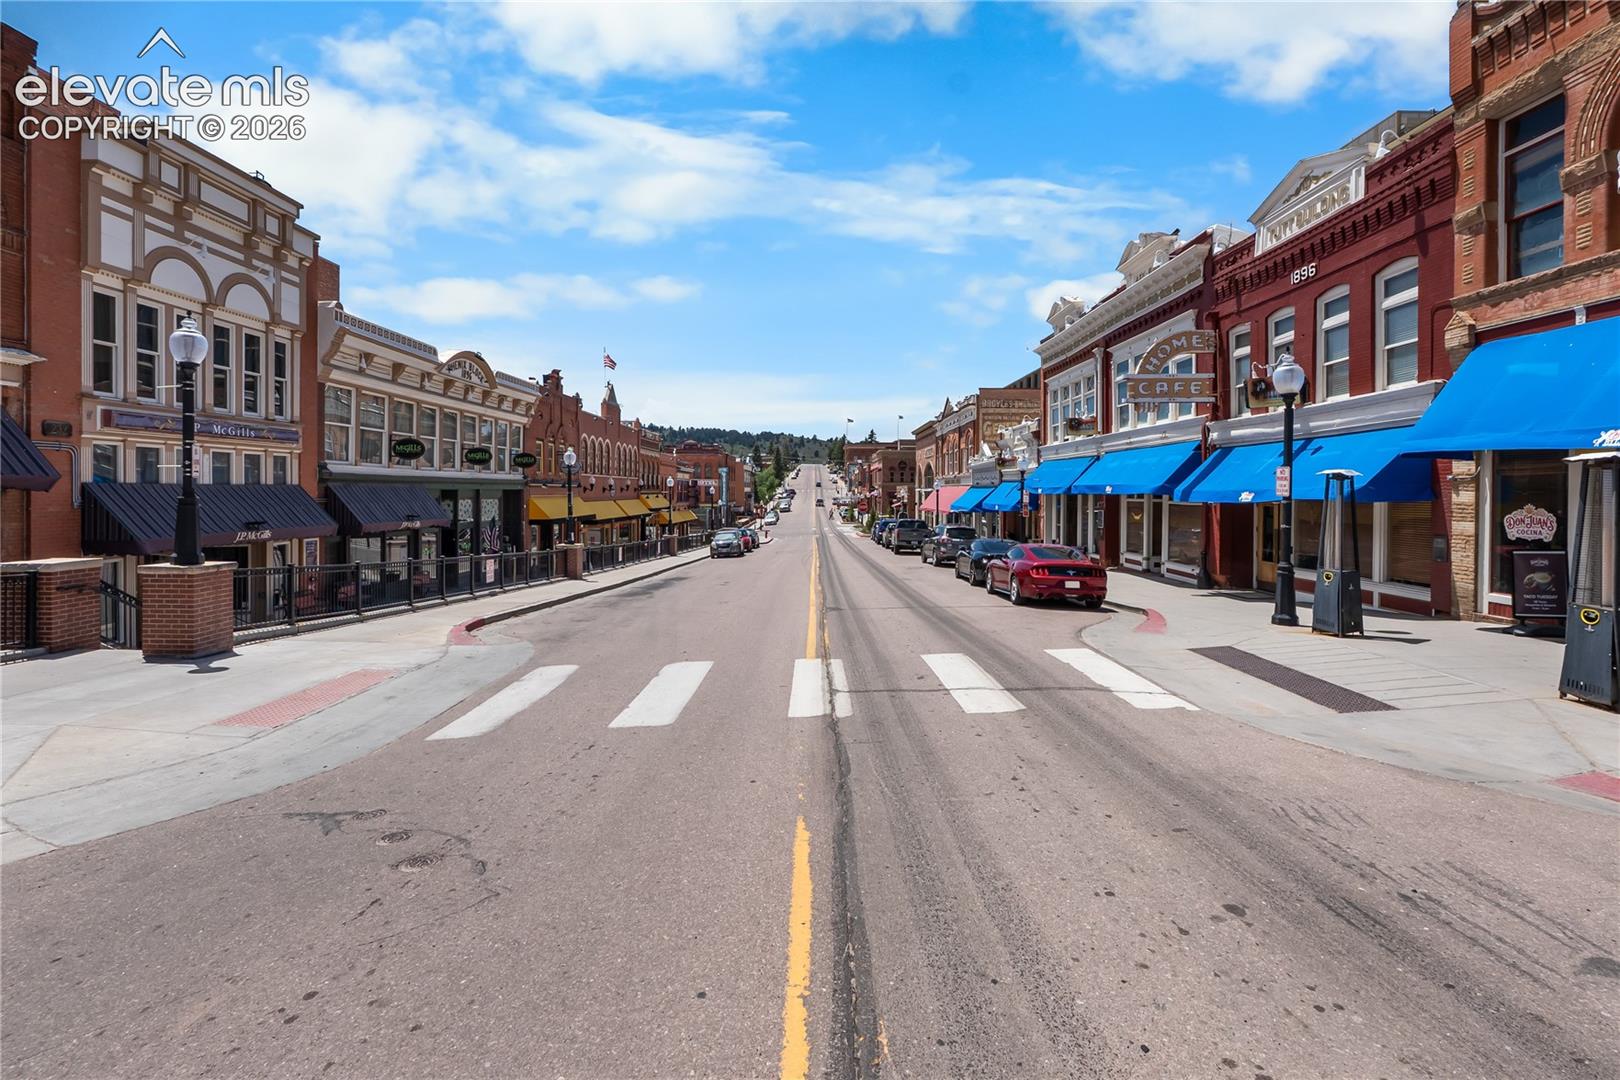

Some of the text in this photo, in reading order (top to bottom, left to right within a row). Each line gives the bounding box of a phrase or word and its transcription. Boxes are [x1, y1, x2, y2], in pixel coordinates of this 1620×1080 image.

[1290, 262, 1318, 285] 1896
[1145, 335, 1204, 371] HOME
[1138, 381, 1203, 395] CAFE
[212, 424, 256, 438] McGills
[1505, 515, 1525, 530] DON
